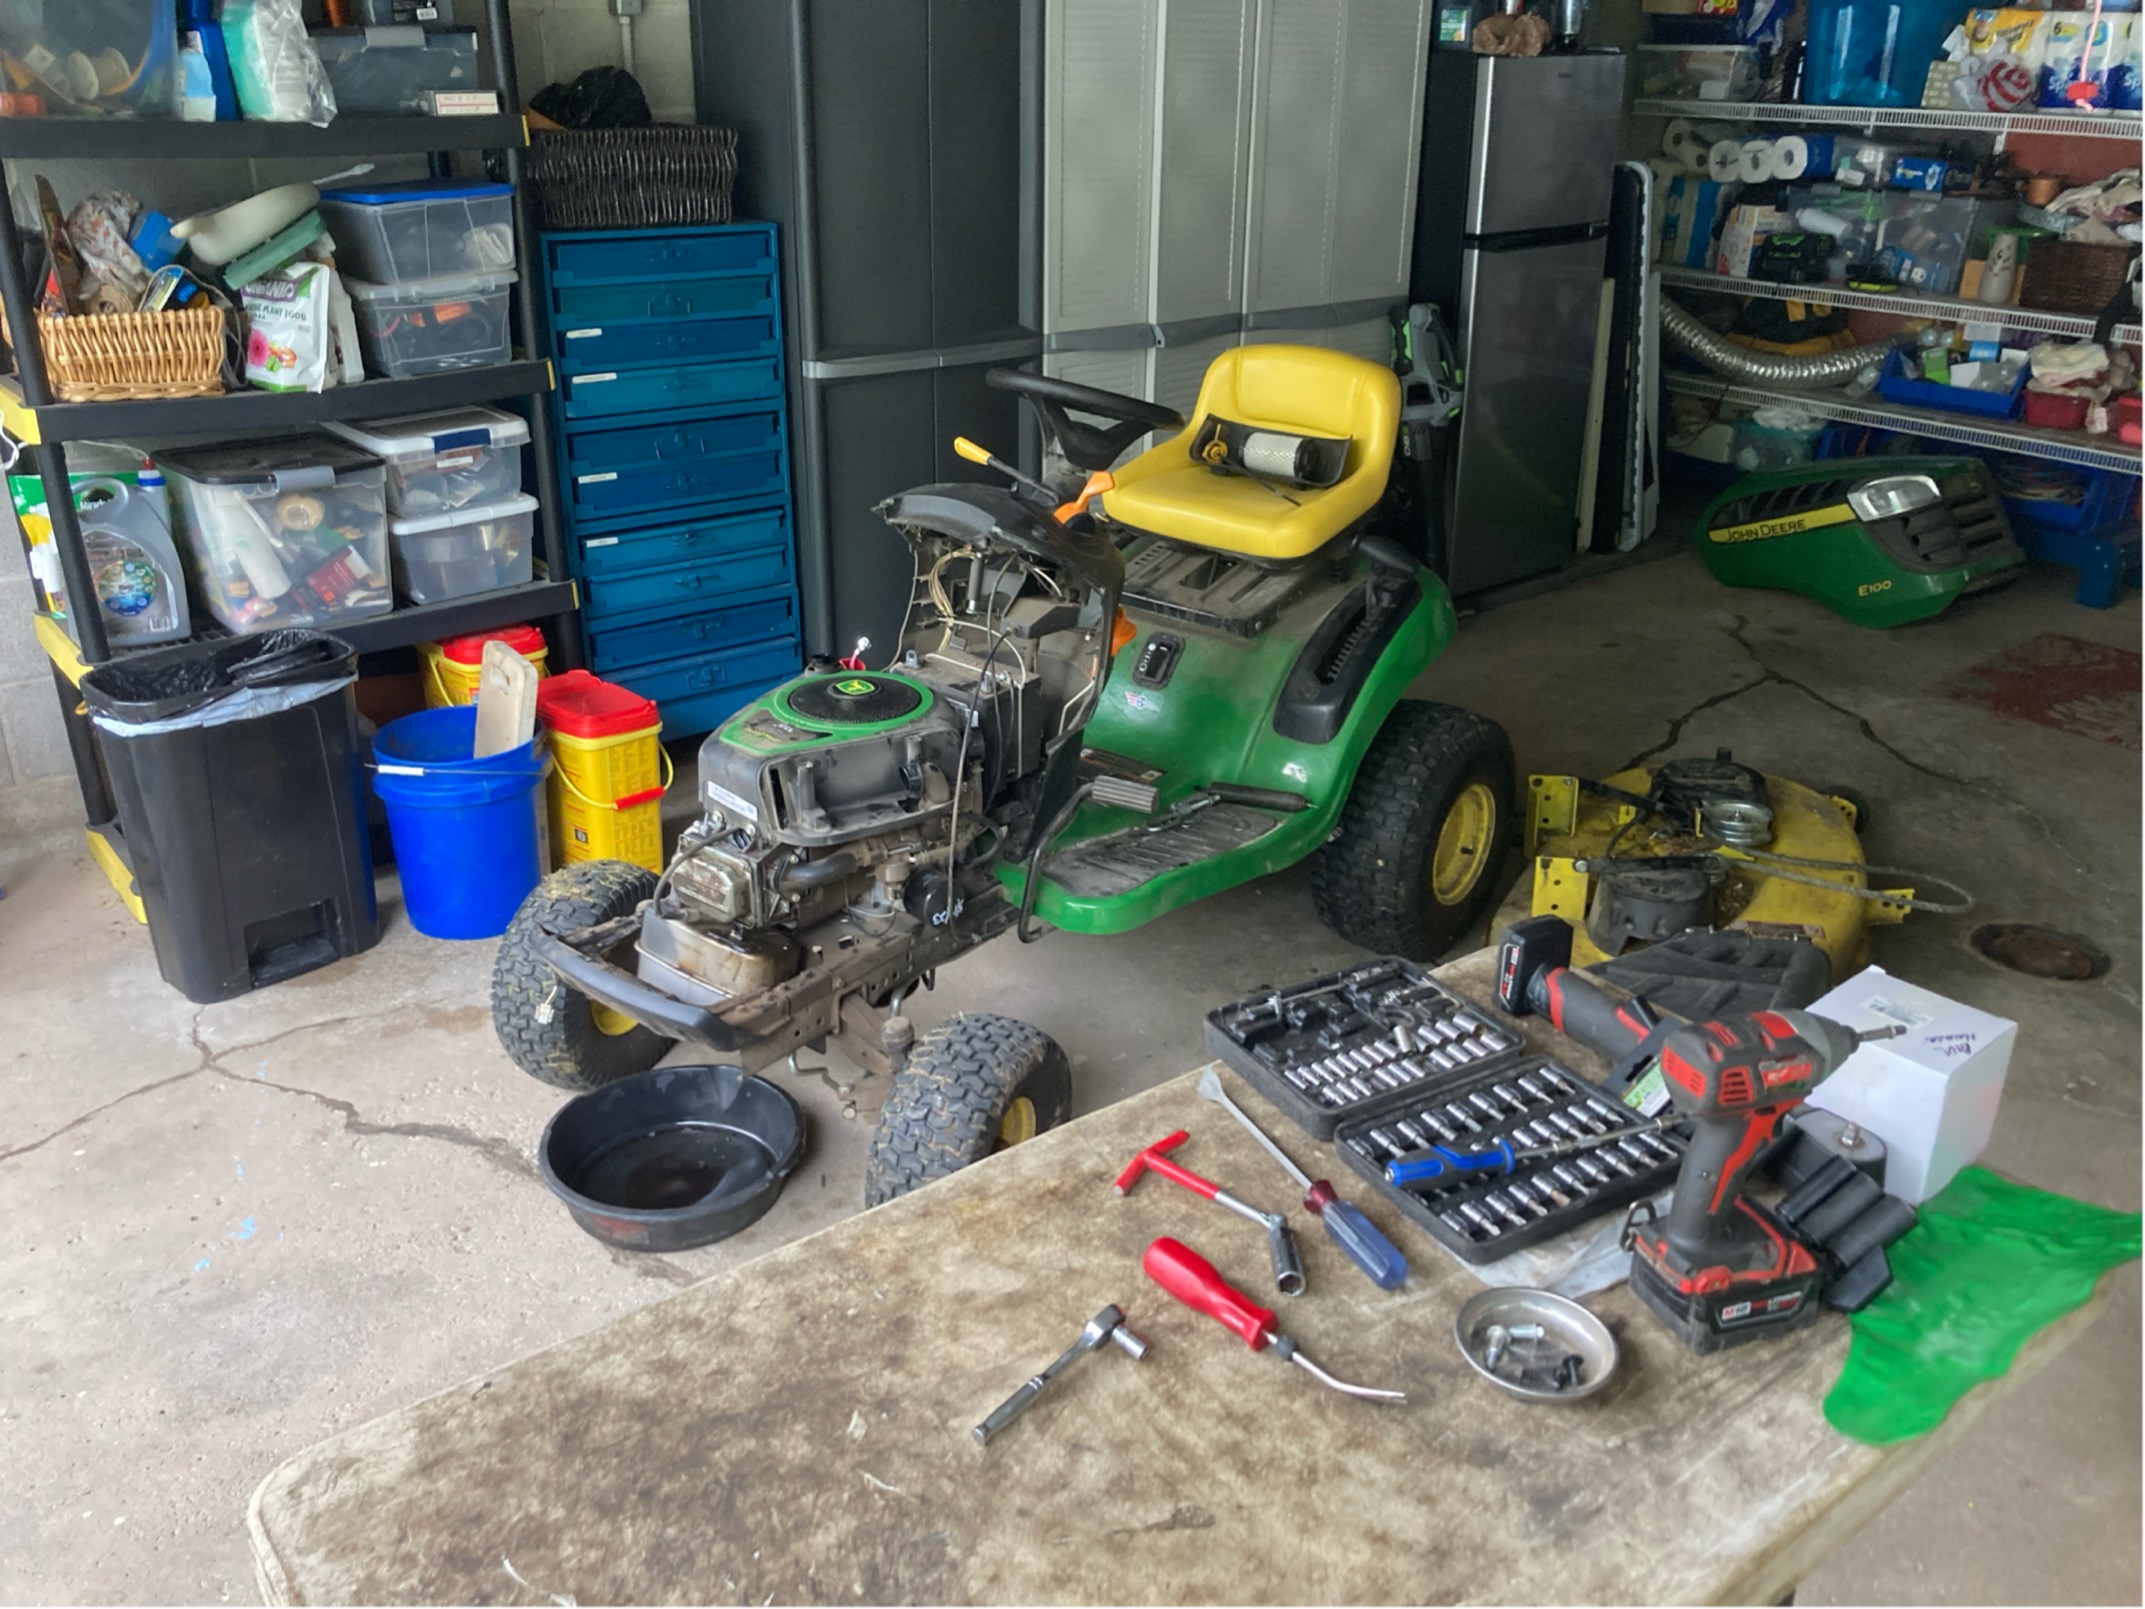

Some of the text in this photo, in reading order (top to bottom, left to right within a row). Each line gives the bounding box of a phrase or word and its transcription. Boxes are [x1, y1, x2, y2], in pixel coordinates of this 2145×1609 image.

[1726, 519, 1807, 542] JOHN DEERE
[1858, 580, 1892, 597] E100
